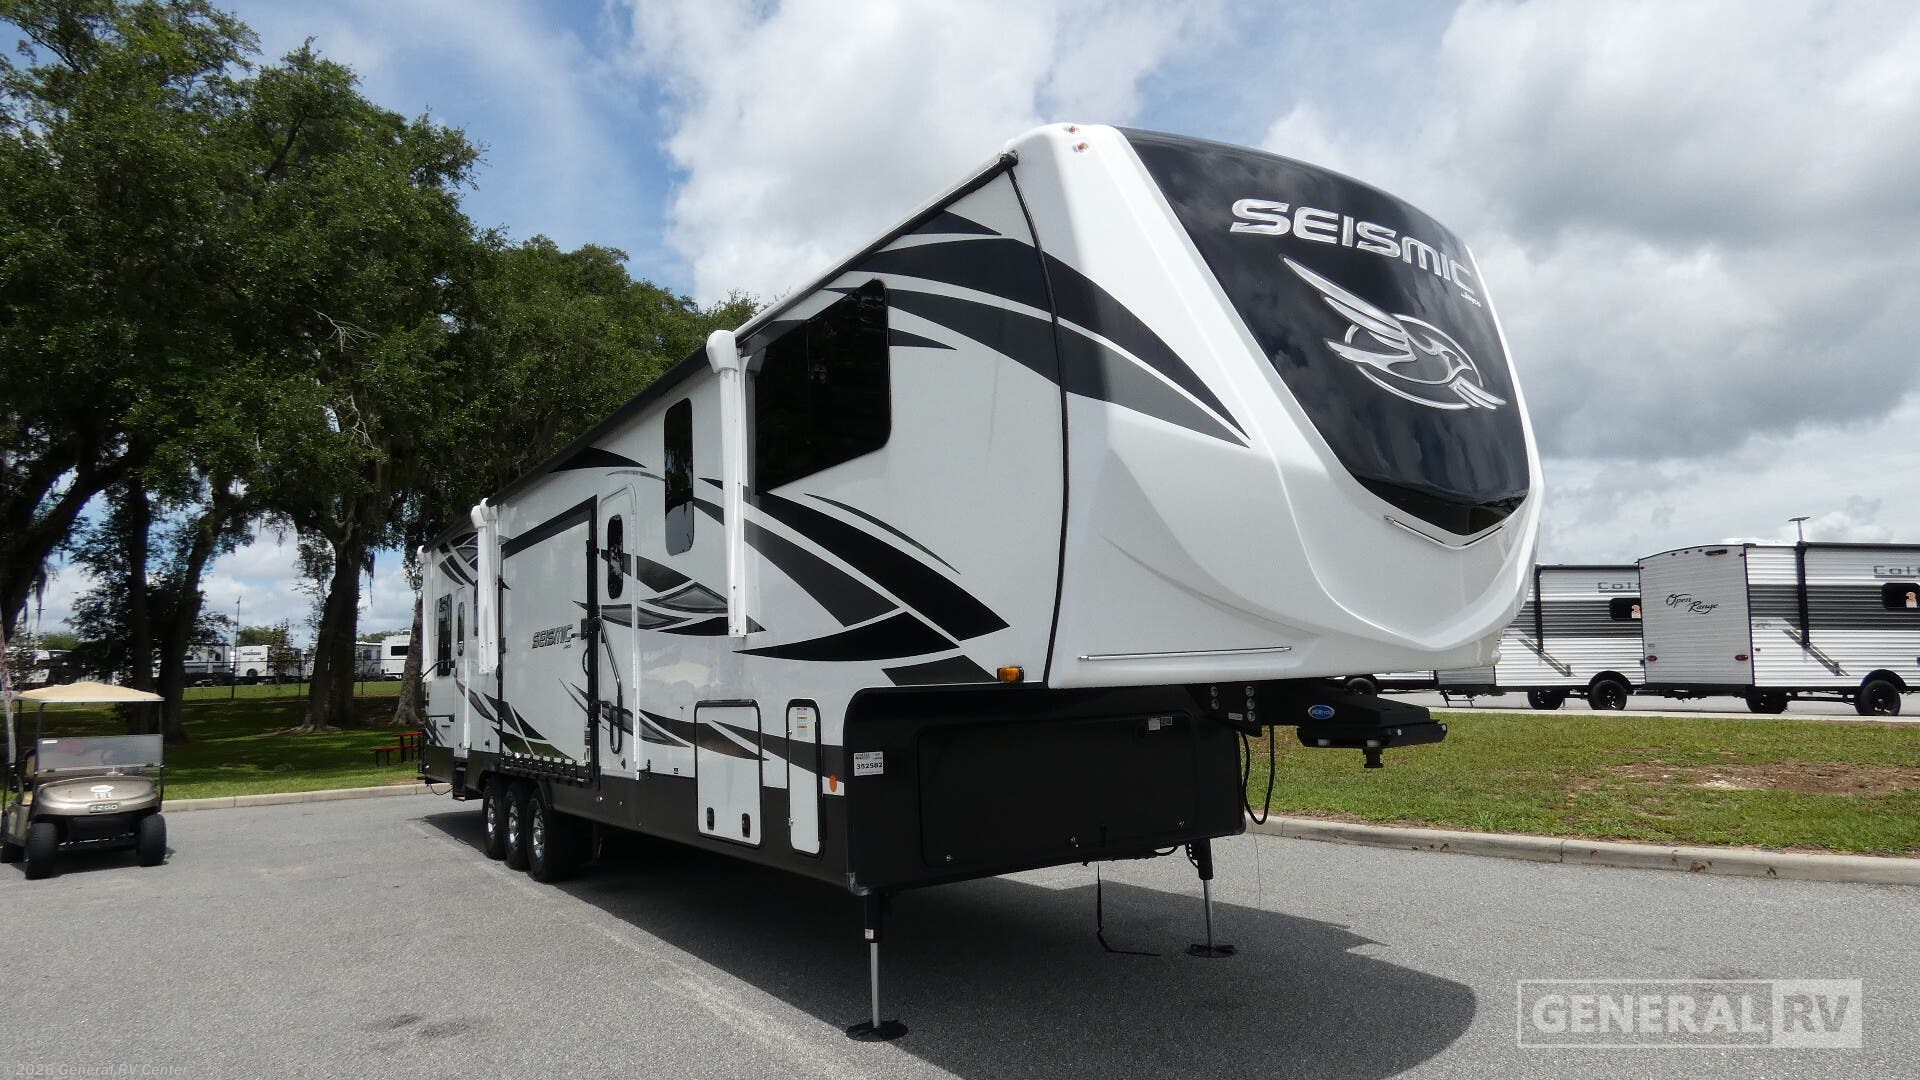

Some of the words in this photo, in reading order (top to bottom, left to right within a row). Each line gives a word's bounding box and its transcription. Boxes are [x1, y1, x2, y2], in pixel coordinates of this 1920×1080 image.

[1229, 197, 1475, 295] SEISMIC
[1665, 593, 1693, 608] Open
[1687, 600, 1719, 615] Range
[532, 624, 573, 649] SEISMIC
